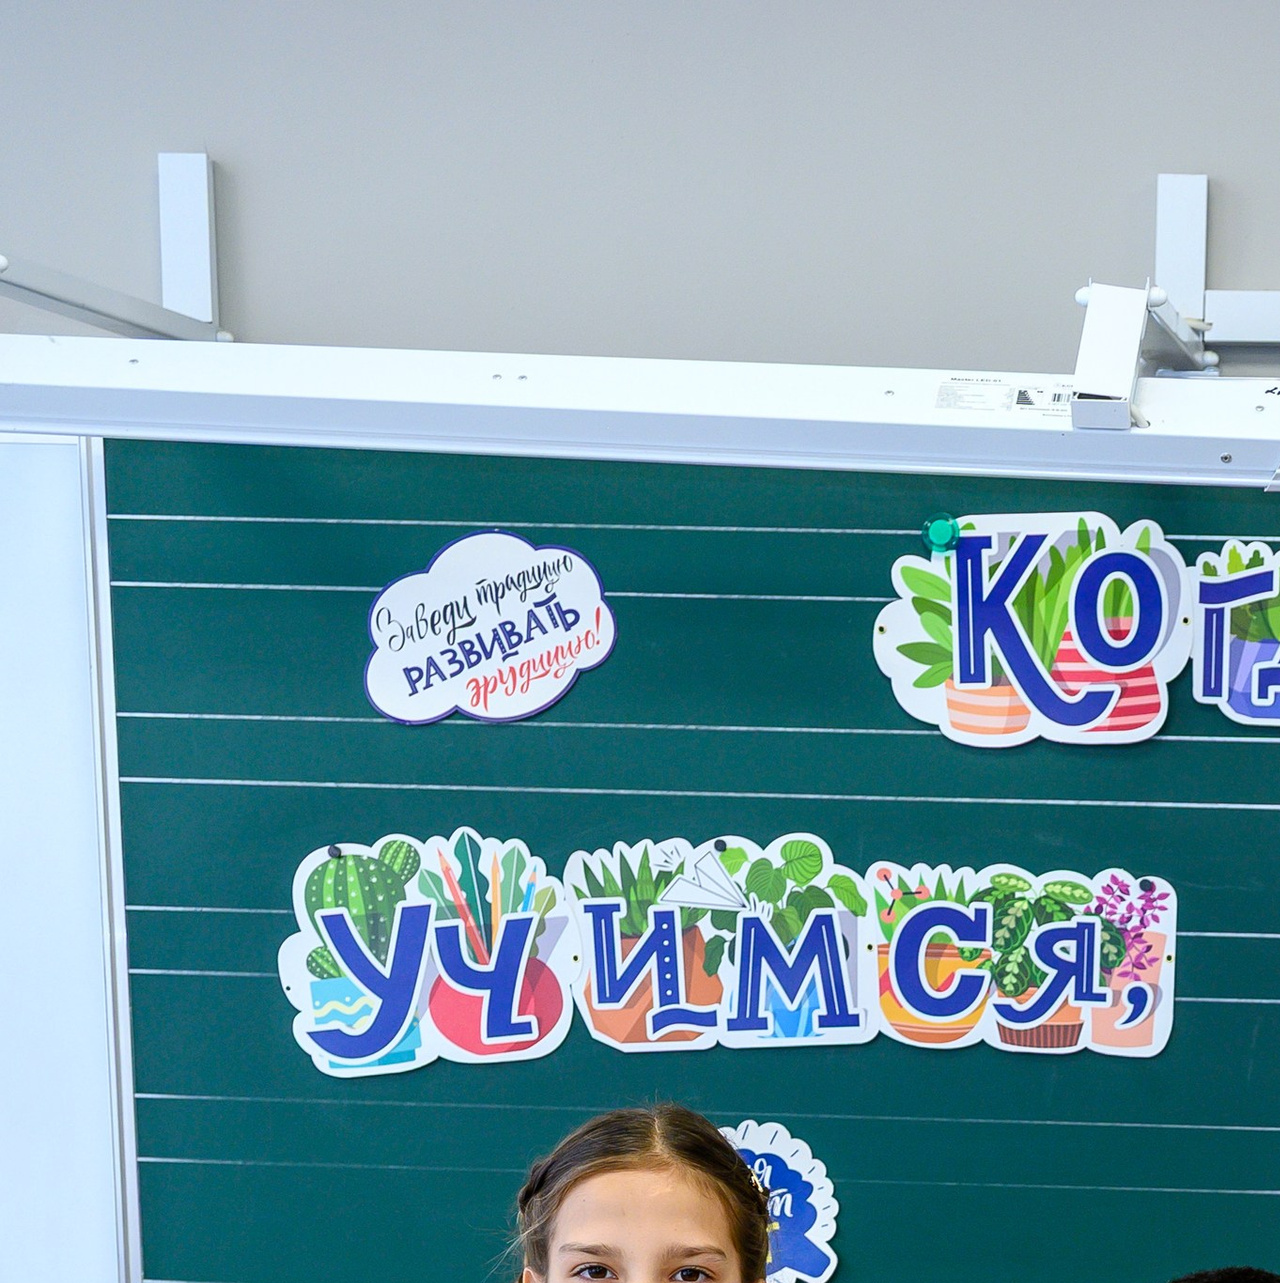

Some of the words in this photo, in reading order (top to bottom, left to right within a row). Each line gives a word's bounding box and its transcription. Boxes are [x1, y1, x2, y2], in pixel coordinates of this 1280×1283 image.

[375, 595, 477, 652] Заведи
[474, 554, 574, 616] традицию
[402, 592, 581, 697] РАЗВИВАТЬ
[465, 606, 602, 713] эрудицию!
